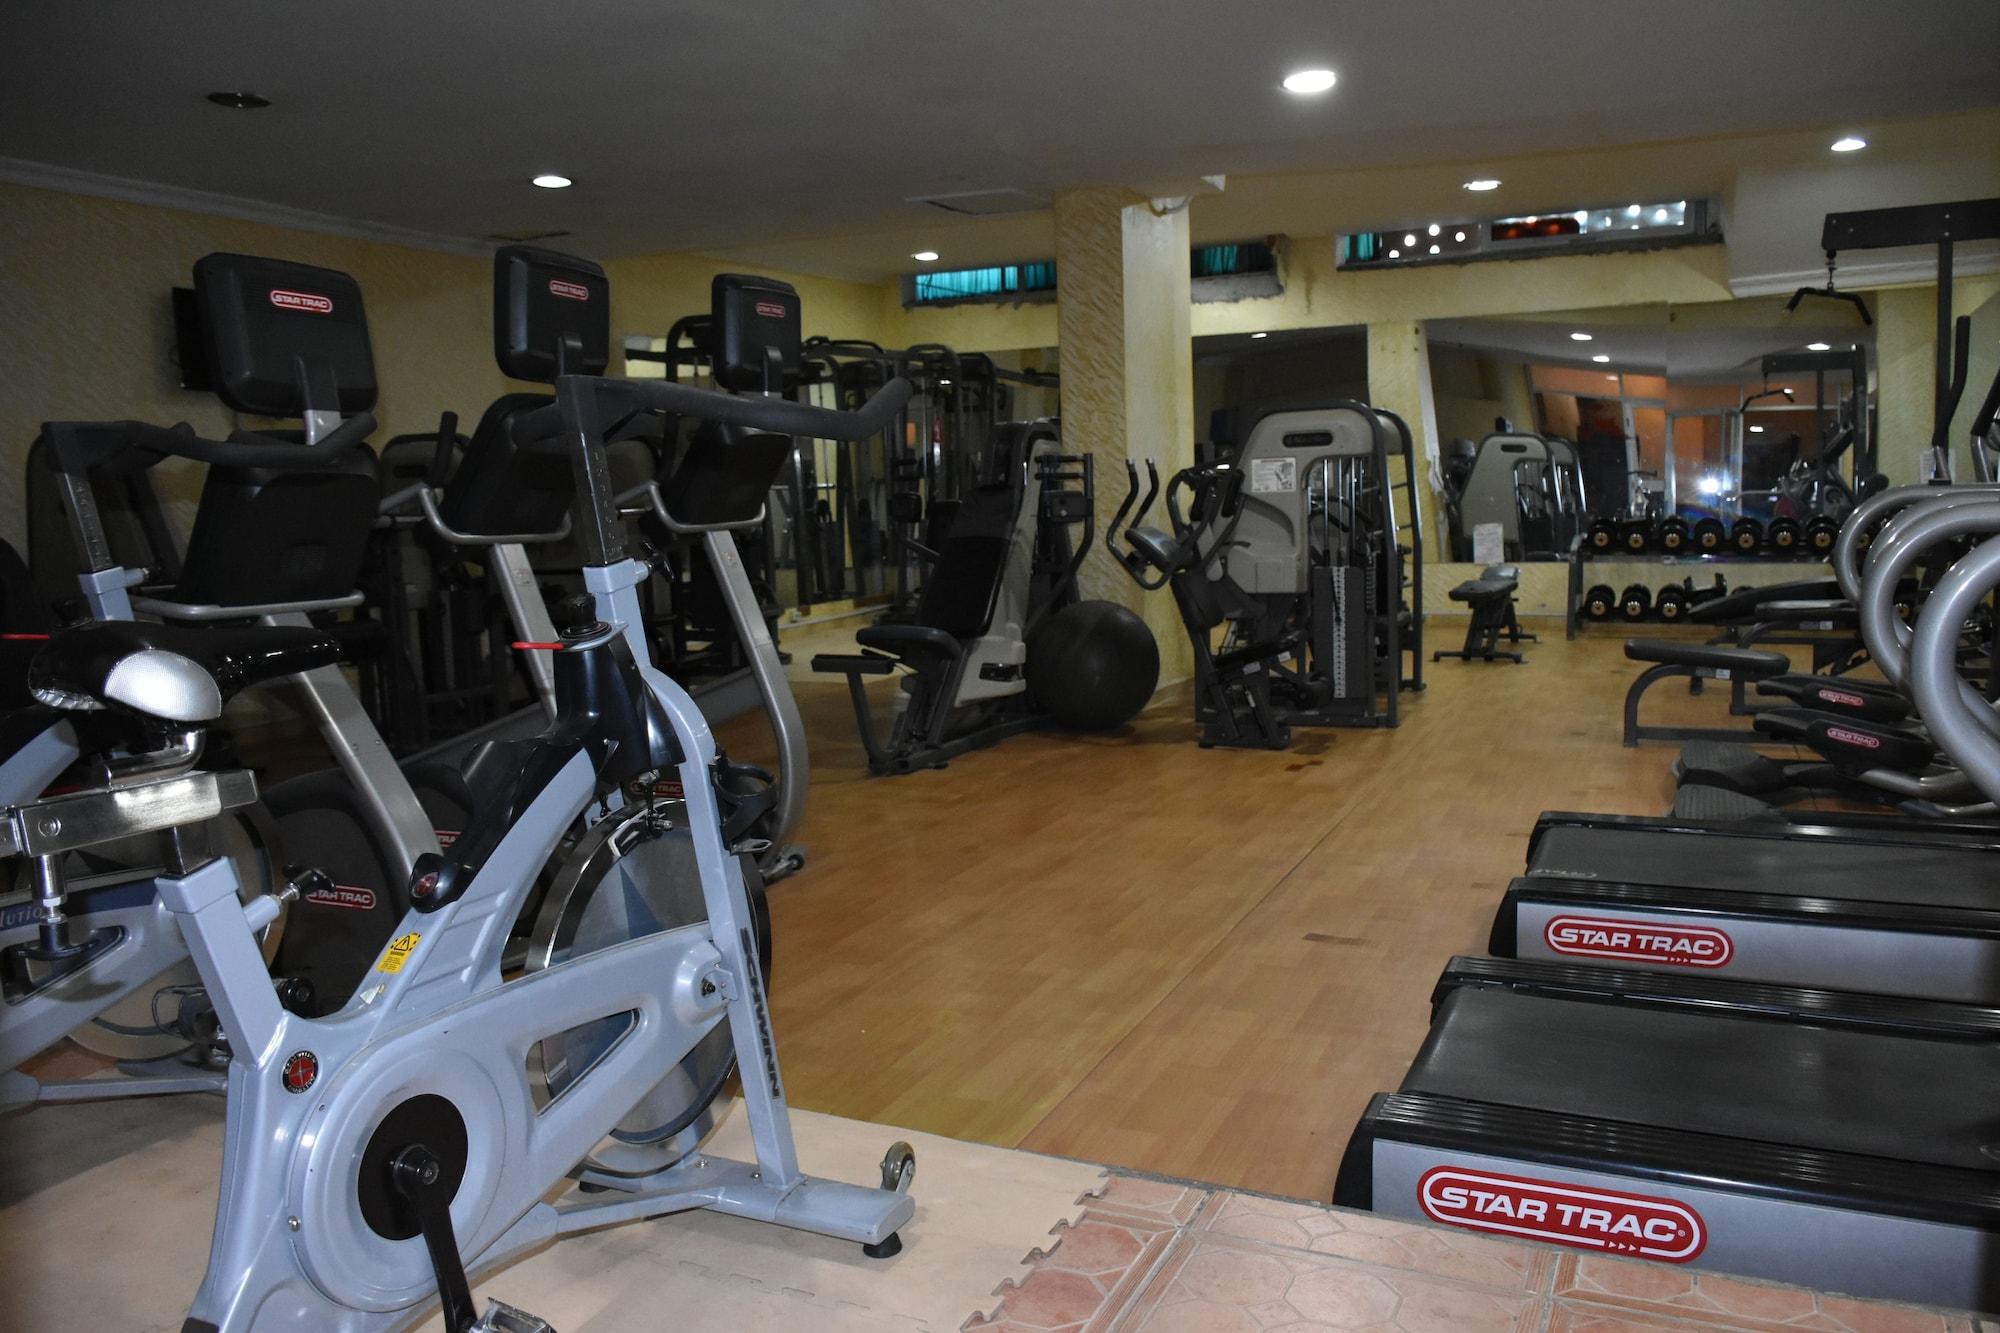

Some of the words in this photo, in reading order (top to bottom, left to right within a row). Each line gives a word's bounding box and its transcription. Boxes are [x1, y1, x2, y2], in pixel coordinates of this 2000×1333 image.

[274, 294, 300, 305] STAR
[301, 297, 328, 308] TRAC
[340, 891, 371, 904] TRAC
[1553, 927, 1632, 948] STAR
[1636, 934, 1715, 955] TRAC
[740, 927, 780, 1097] SCHWINN
[1433, 1186, 1549, 1222] STAR
[1556, 1203, 1678, 1243] TRAC
